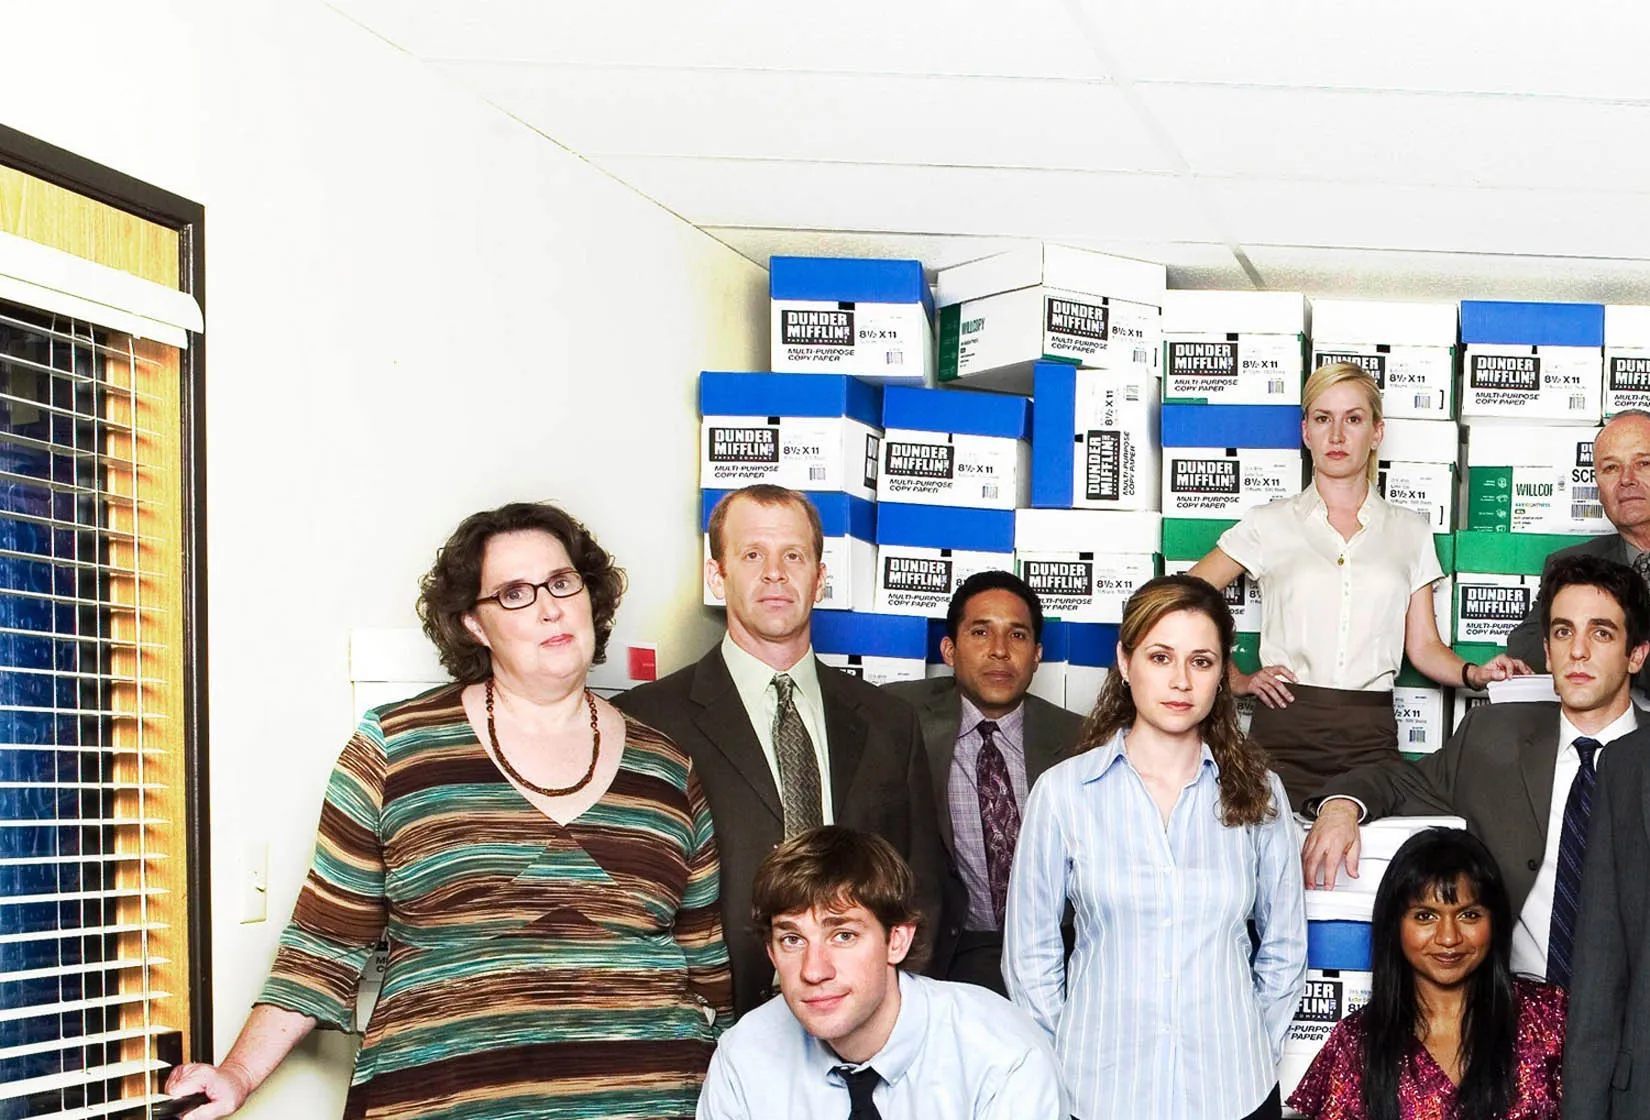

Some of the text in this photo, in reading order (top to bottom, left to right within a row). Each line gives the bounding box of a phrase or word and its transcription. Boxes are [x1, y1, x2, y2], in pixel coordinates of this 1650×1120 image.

[1053, 300, 1103, 320] DUNDER
[788, 311, 847, 326] DUNDER
[1128, 329, 1135, 337] X
[1136, 330, 1143, 338] 11
[1051, 343, 1071, 351] COPY
[1175, 344, 1231, 357] DUNDER
[1261, 360, 1268, 368] X
[1477, 357, 1533, 371] DUNDER
[1408, 374, 1415, 382] X
[1106, 390, 1114, 398] 11
[715, 430, 772, 443] DUNDER
[892, 444, 947, 459] DUNDER
[976, 465, 983, 473] X
[1088, 437, 1101, 494] DUNDER
[1177, 461, 1233, 474] DUNDER
[1263, 478, 1270, 486] X
[1409, 490, 1416, 498] X
[1417, 491, 1425, 499] 11
[890, 559, 946, 574] DUNDER
[1030, 563, 1086, 576] DUNDER
[1115, 580, 1123, 588] X
[1468, 588, 1523, 601] DUNDER
[888, 599, 910, 607] COPY
[1304, 983, 1334, 999] DER
[1291, 1033, 1324, 1041] PAPER
